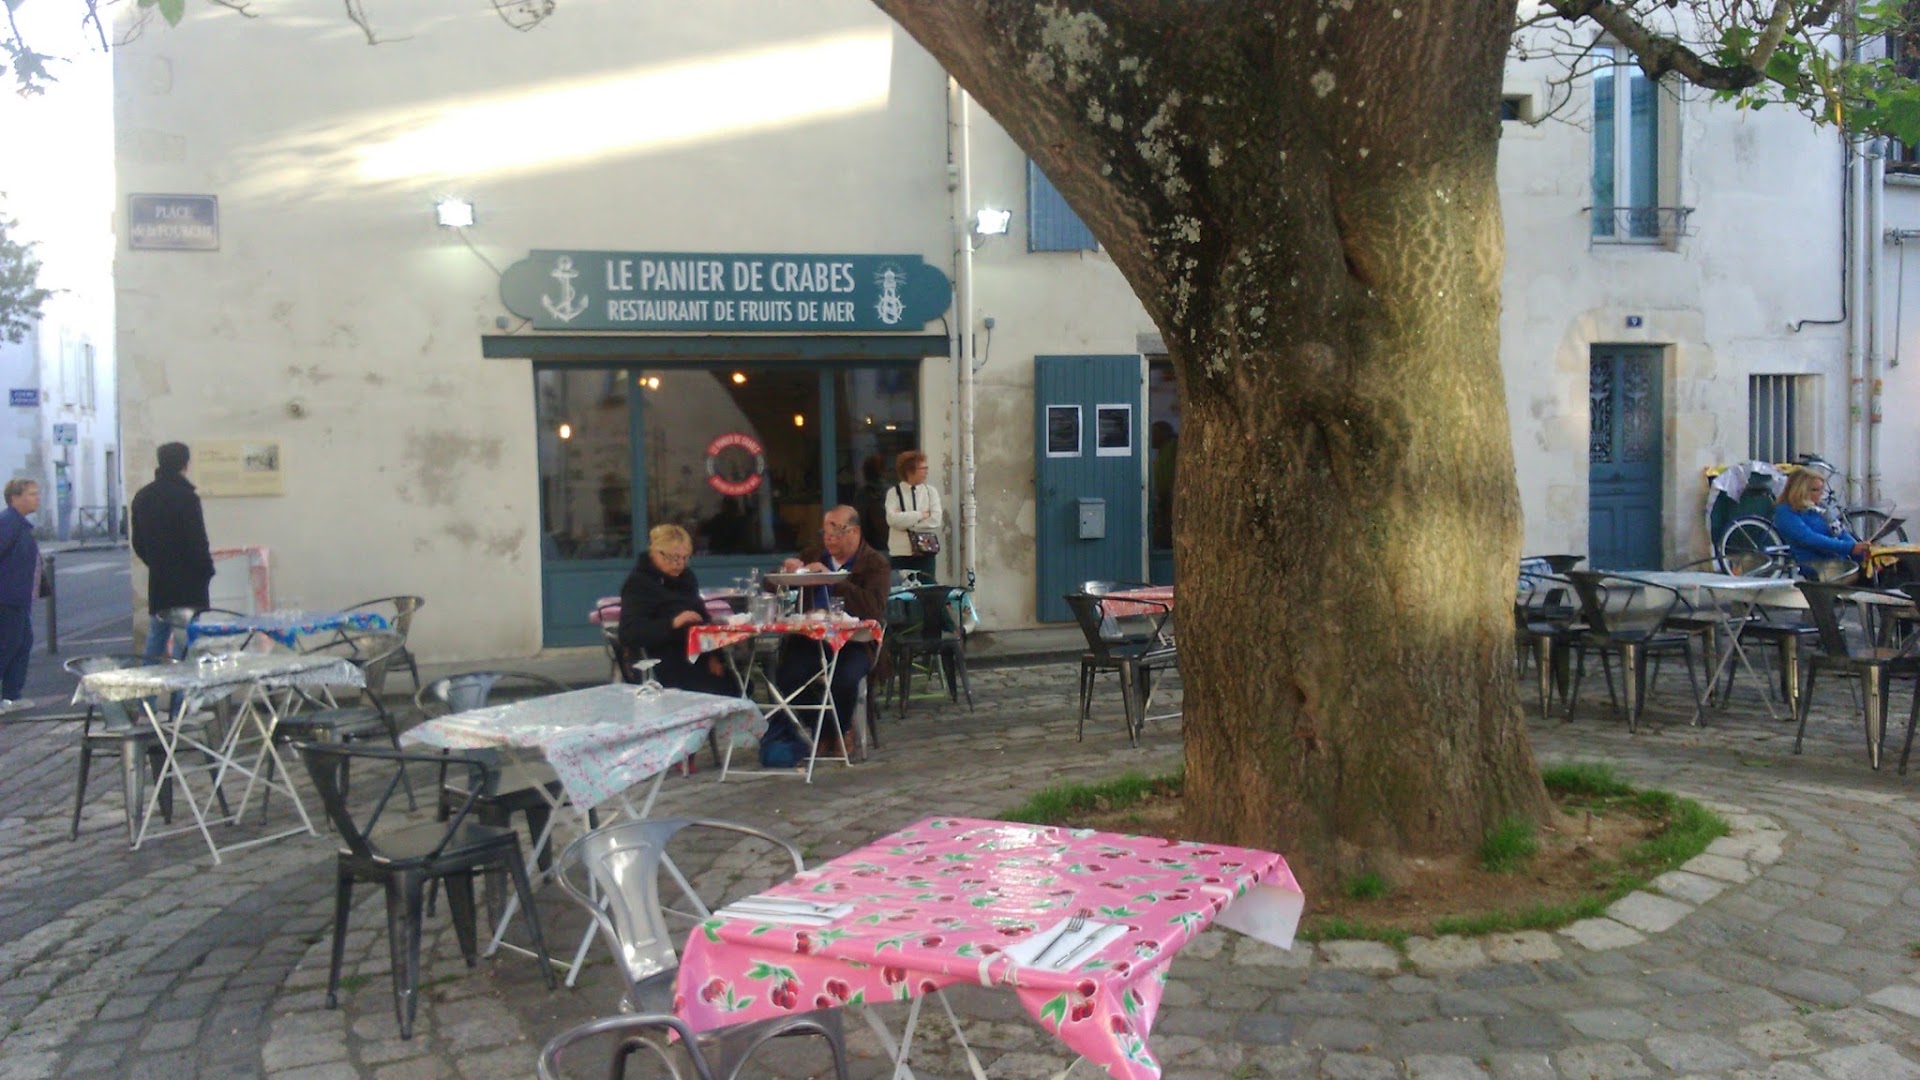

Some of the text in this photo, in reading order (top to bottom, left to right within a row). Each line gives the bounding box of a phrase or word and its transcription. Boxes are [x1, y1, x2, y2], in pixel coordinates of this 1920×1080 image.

[155, 205, 192, 219] PLACE
[606, 260, 855, 293] LE PANIER DE CRABES
[607, 300, 855, 322] RESTAURANT DE FRUITS DE MER
[1631, 317, 1638, 326] 9
